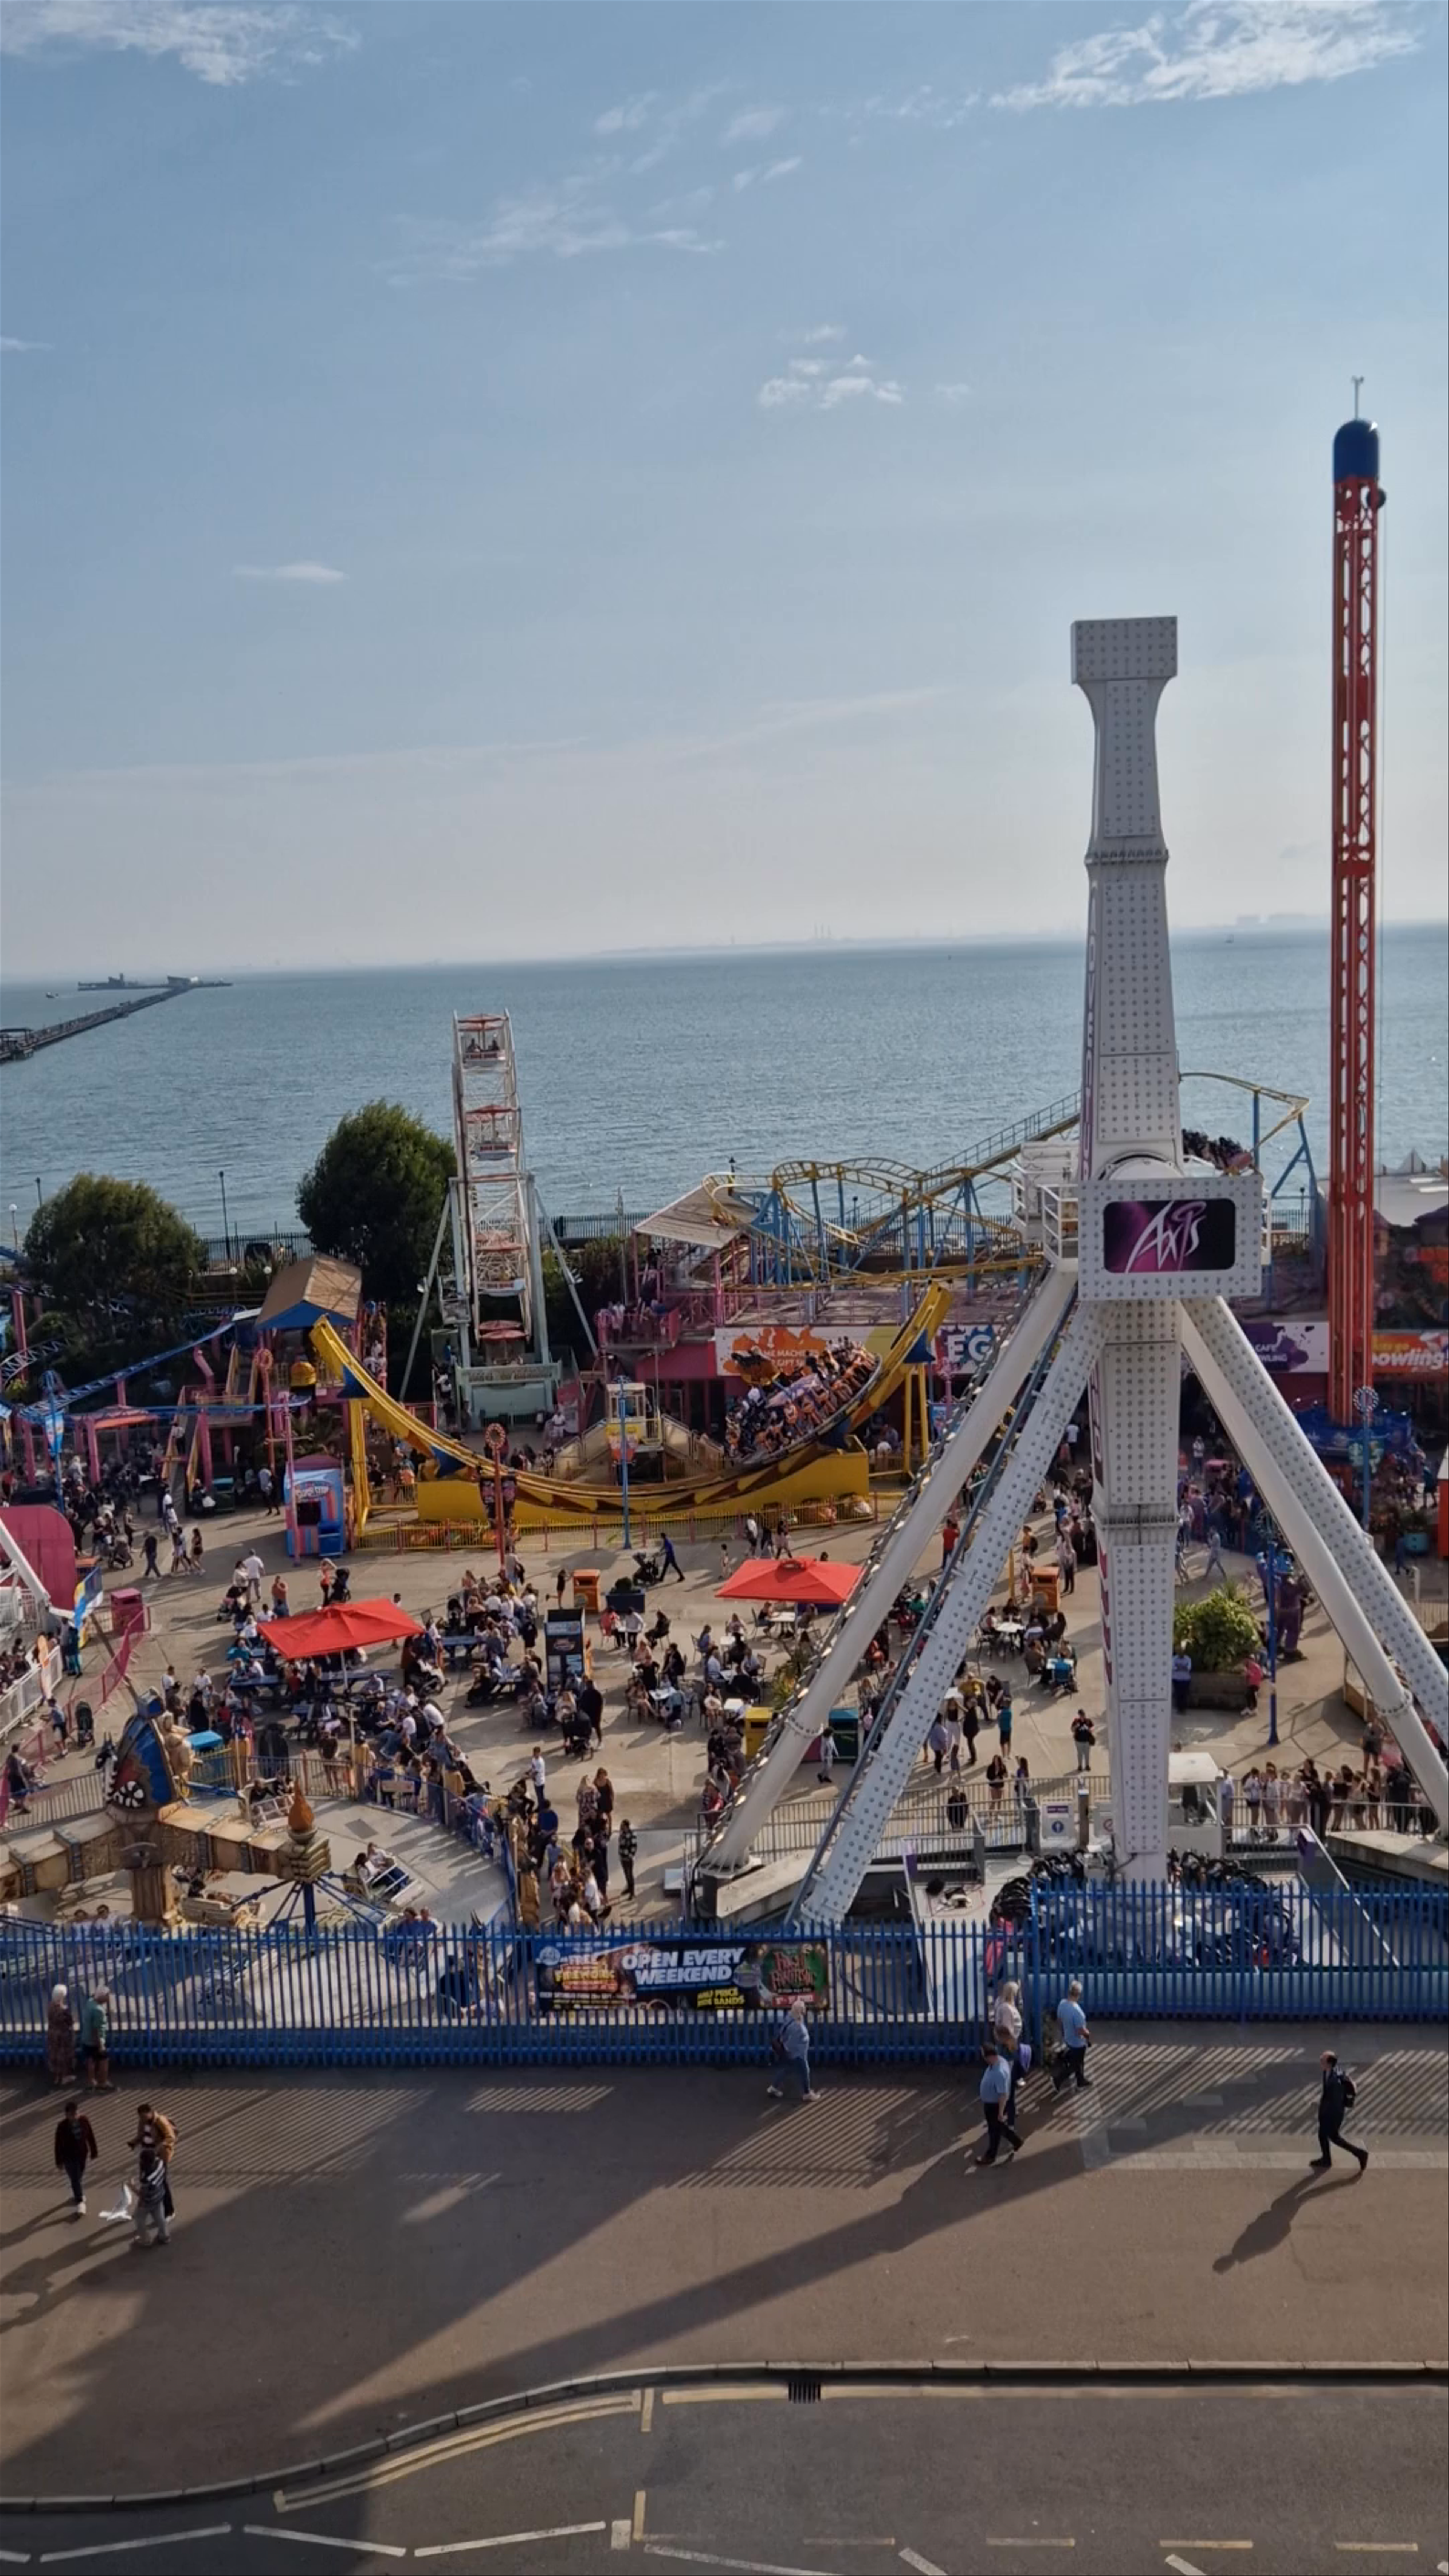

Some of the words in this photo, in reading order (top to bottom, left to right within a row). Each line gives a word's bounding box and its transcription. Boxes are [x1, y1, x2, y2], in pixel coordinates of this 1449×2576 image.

[622, 1952, 678, 1969] OPEN
[683, 1947, 746, 1966] EVERY
[635, 1965, 732, 1984] WEEKEND
